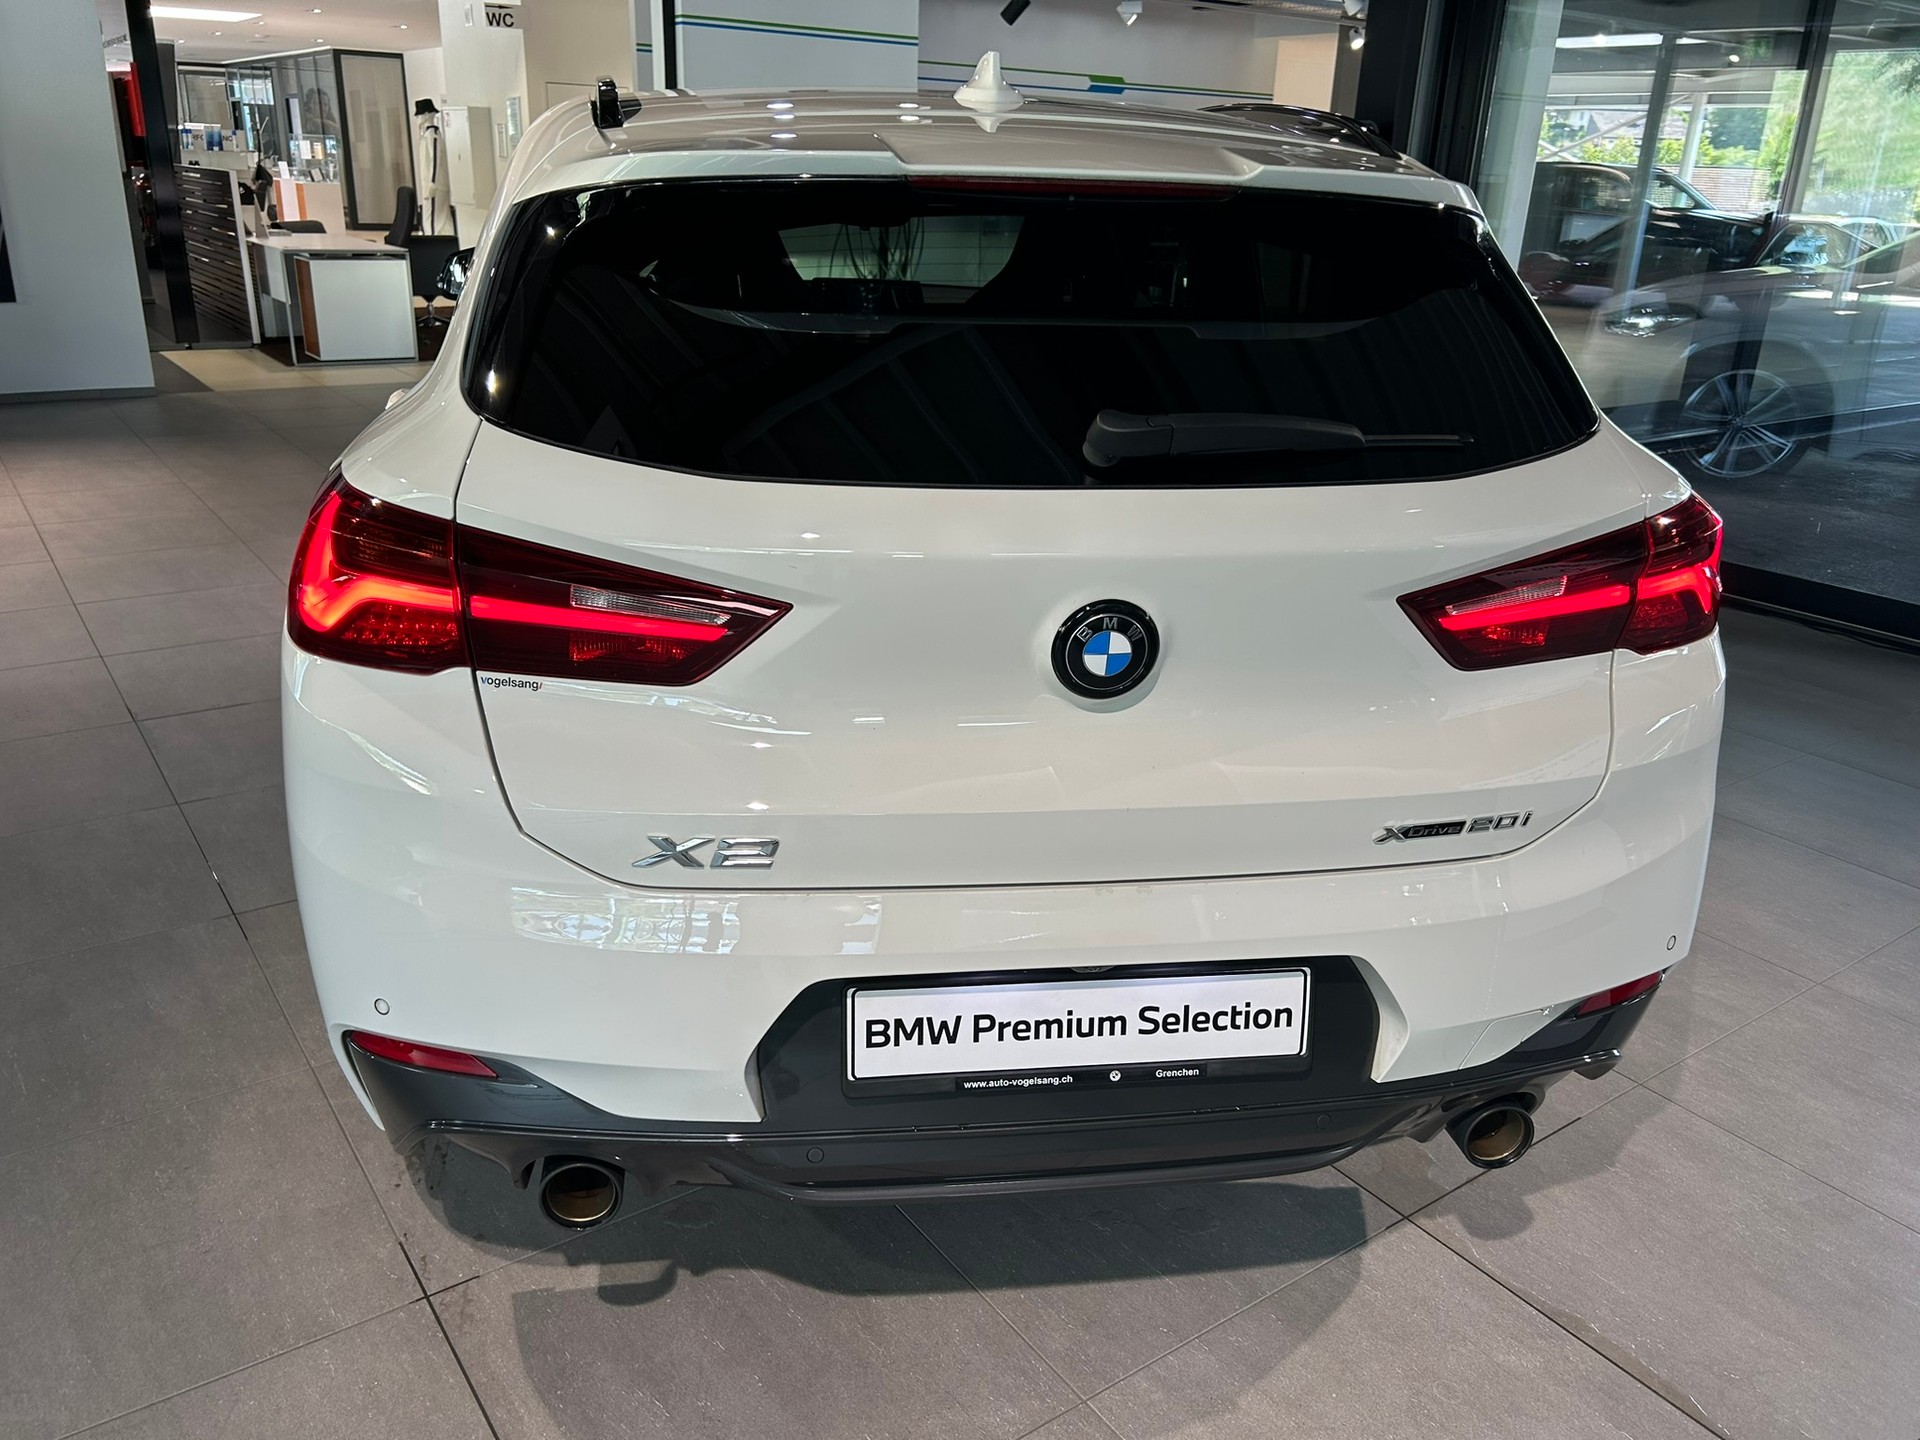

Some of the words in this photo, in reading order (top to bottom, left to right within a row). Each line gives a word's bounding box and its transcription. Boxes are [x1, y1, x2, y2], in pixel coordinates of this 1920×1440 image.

[486, 12, 514, 27] WC
[1076, 617, 1142, 642] BMW
[1466, 810, 1533, 833] 20i
[632, 835, 780, 869] X2
[865, 1015, 961, 1050] BMW
[973, 1008, 1128, 1043] Premium
[1137, 1001, 1293, 1036] Selection
[964, 1075, 1073, 1089] www.auto-vogelsang.ch
[1155, 1068, 1200, 1079] Grenchen
